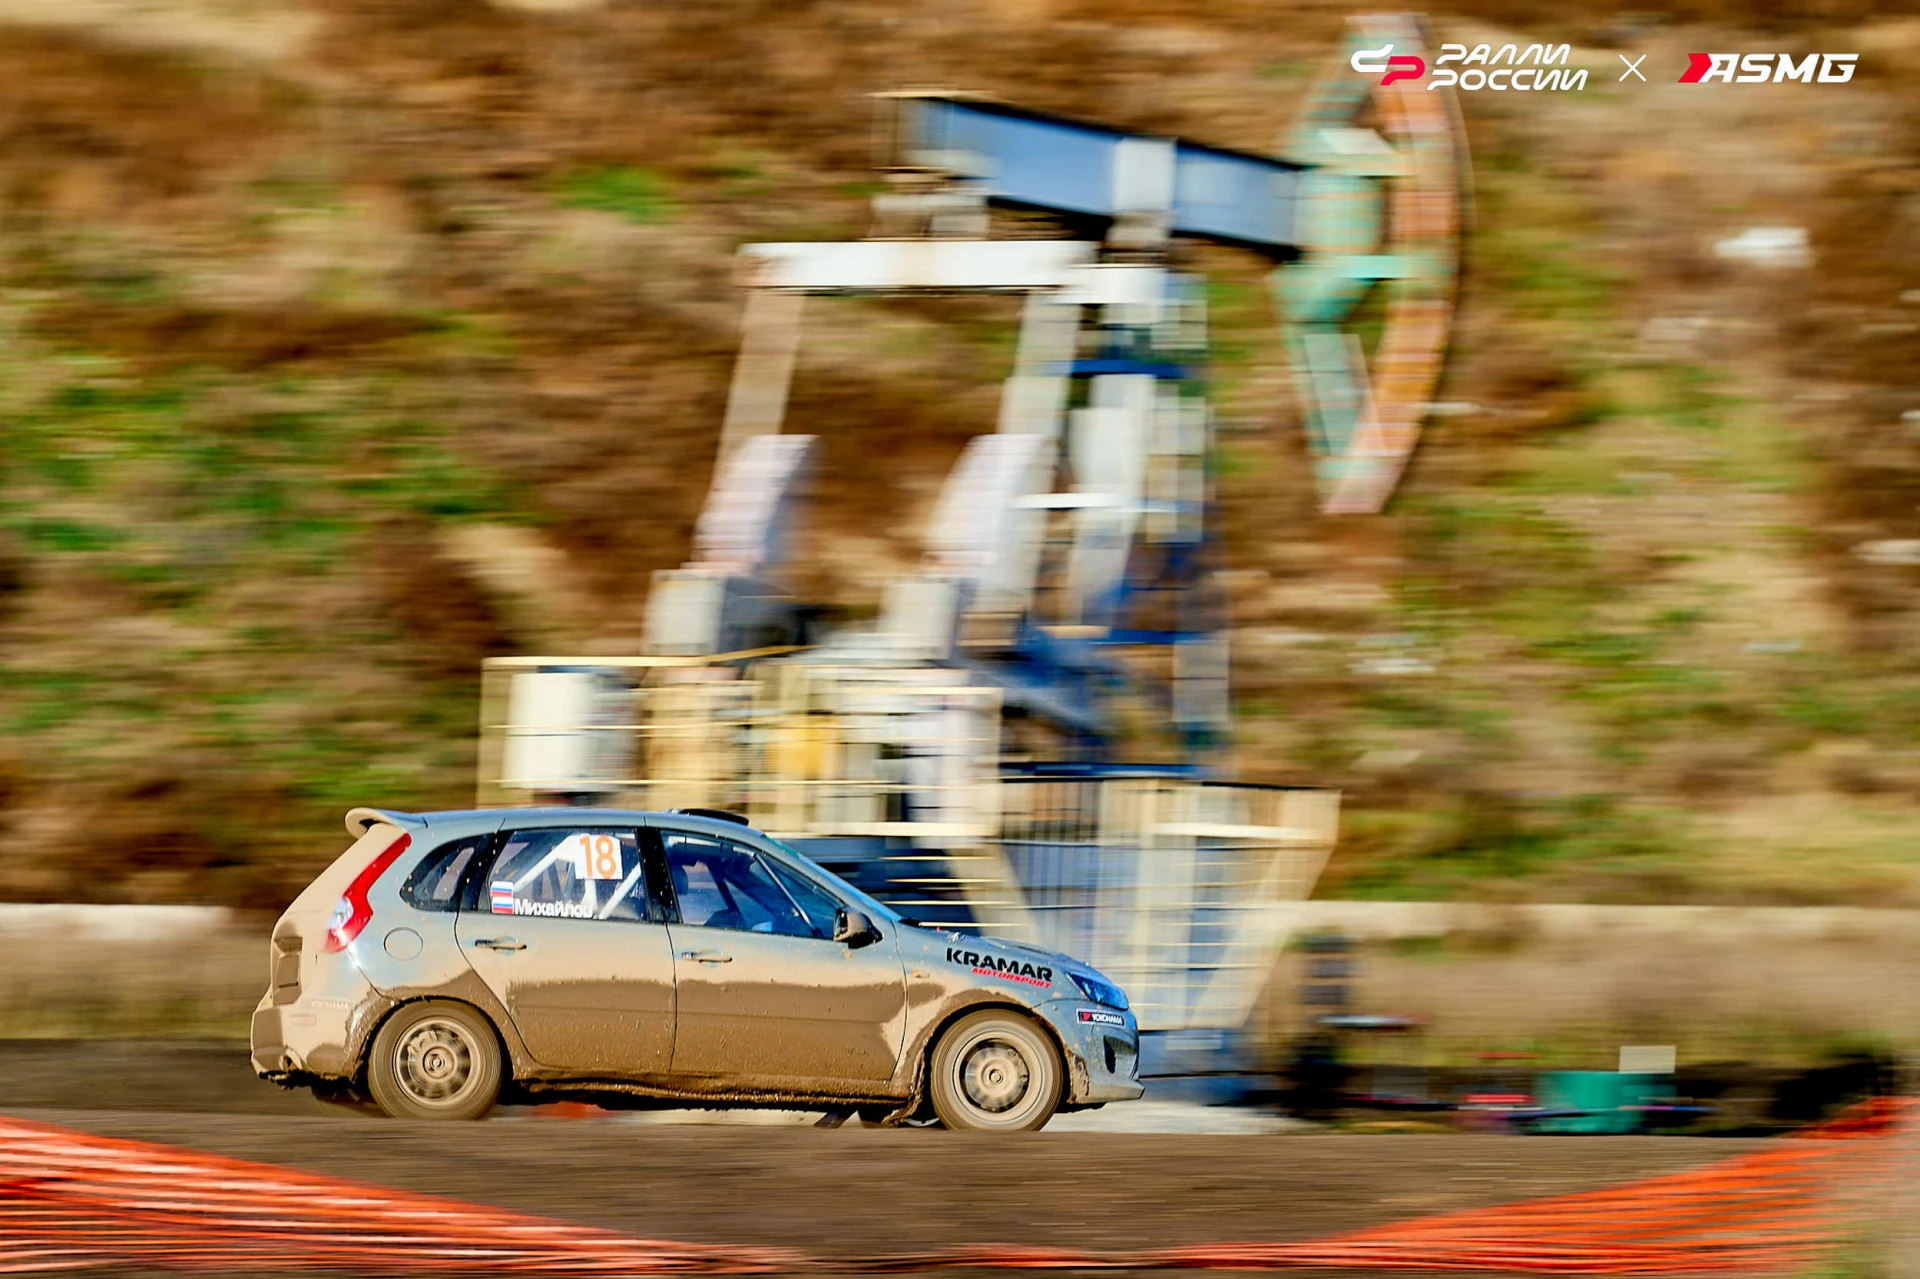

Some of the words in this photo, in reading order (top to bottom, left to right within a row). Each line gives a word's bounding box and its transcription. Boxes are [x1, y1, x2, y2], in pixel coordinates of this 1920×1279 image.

[579, 834, 617, 879] 18
[514, 898, 593, 918] Михайлов
[946, 947, 1053, 983] KRAMAR
[971, 966, 1053, 989] MOTORSPORT
